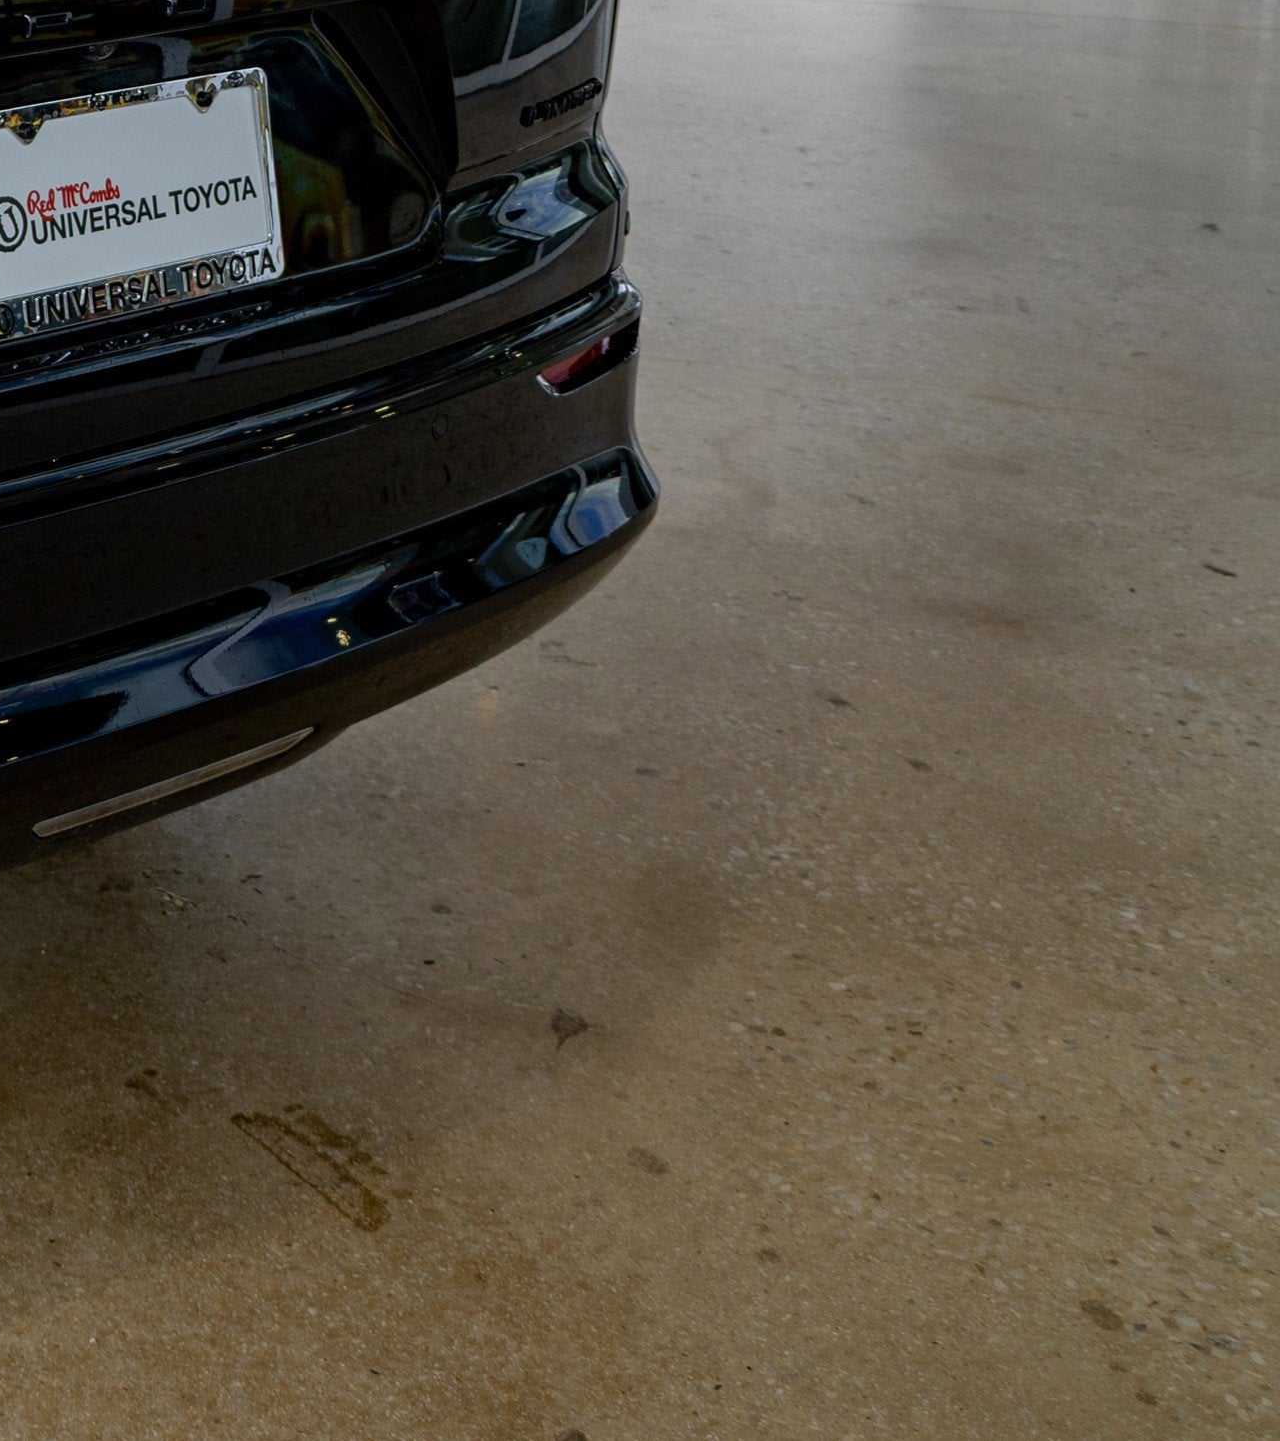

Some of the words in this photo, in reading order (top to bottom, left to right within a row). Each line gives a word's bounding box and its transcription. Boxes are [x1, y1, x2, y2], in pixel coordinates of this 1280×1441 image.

[26, 188, 58, 222] Red
[56, 177, 121, 209] McCombs
[30, 194, 167, 245] UNIVERSAL
[168, 174, 258, 216] TOYOTA
[21, 269, 177, 329] UNIVERSAL
[177, 247, 277, 293] TOYOTA
